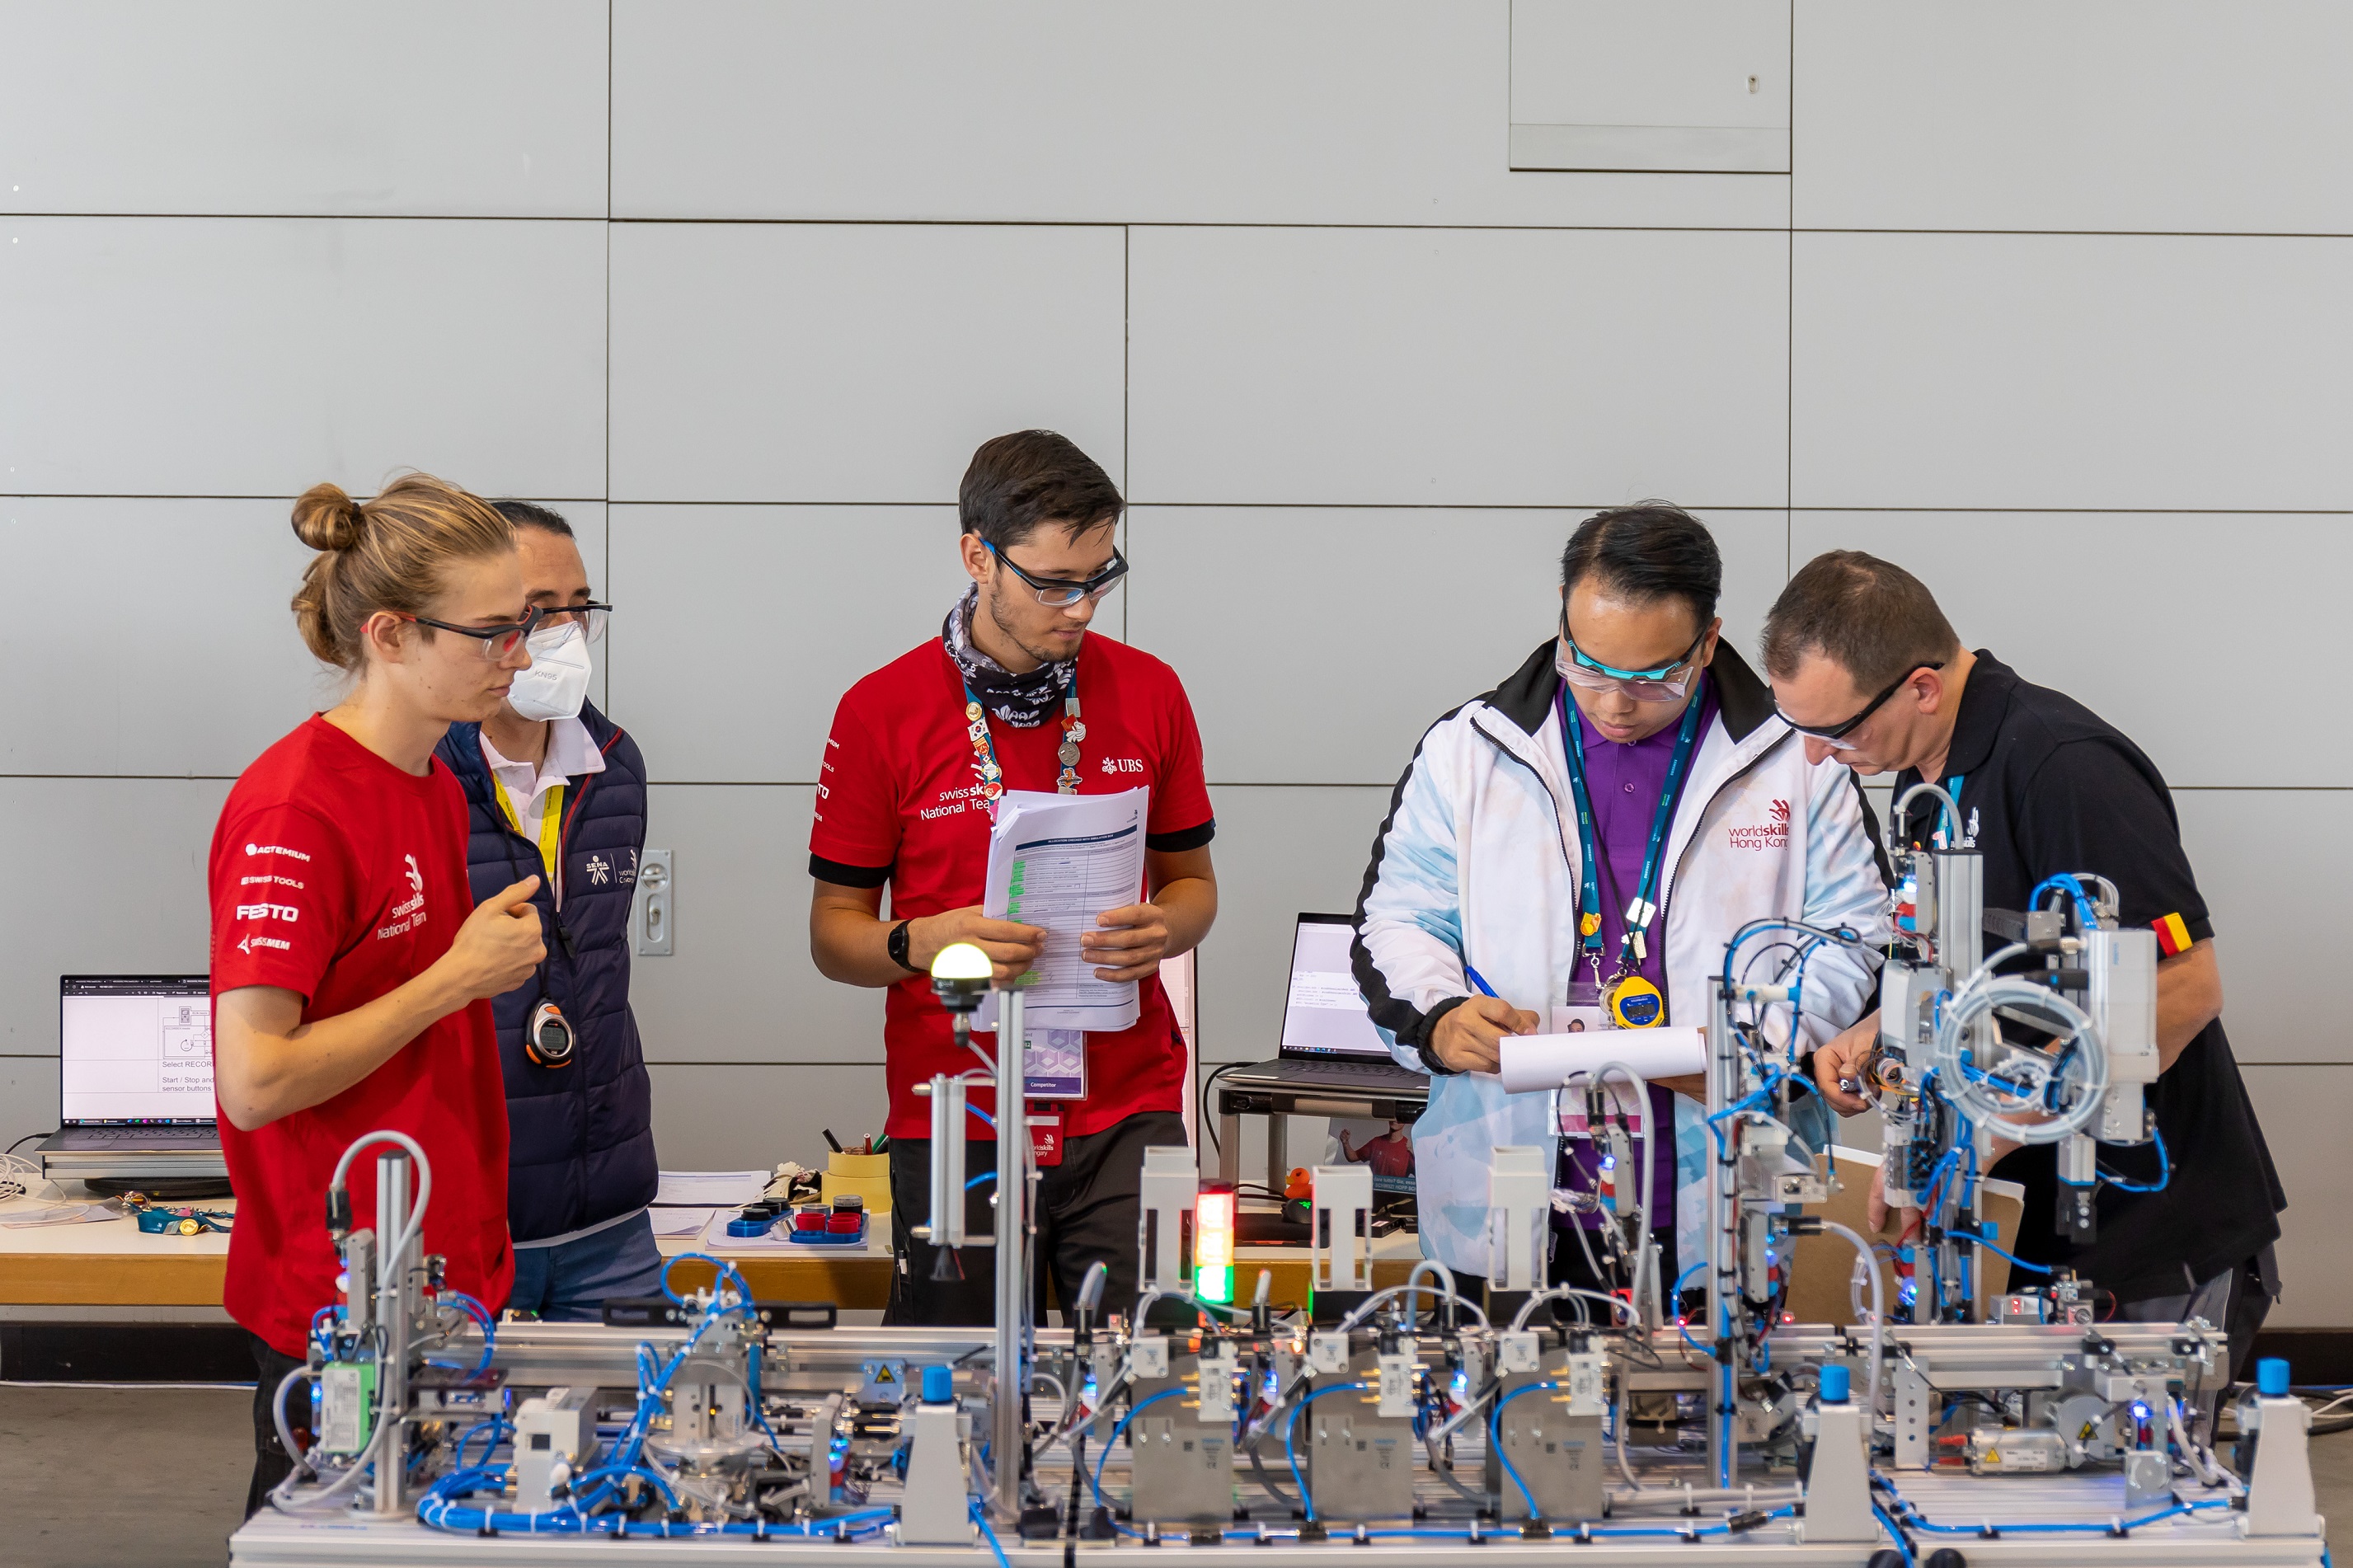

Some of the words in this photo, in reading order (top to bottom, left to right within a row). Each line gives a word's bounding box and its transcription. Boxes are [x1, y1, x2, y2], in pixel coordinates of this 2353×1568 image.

[534, 670, 557, 681] KN95
[1117, 758, 1144, 772] UBS
[817, 782, 829, 800] TO
[938, 782, 986, 801] swissski
[920, 800, 965, 821] National
[969, 798, 990, 810] Tea
[1730, 837, 1762, 852] Hong
[256, 845, 311, 862] ACTEMIUM
[249, 875, 272, 885] SWISS
[274, 876, 304, 890] TOOLS
[237, 904, 299, 922] FESTO
[377, 916, 411, 941] National
